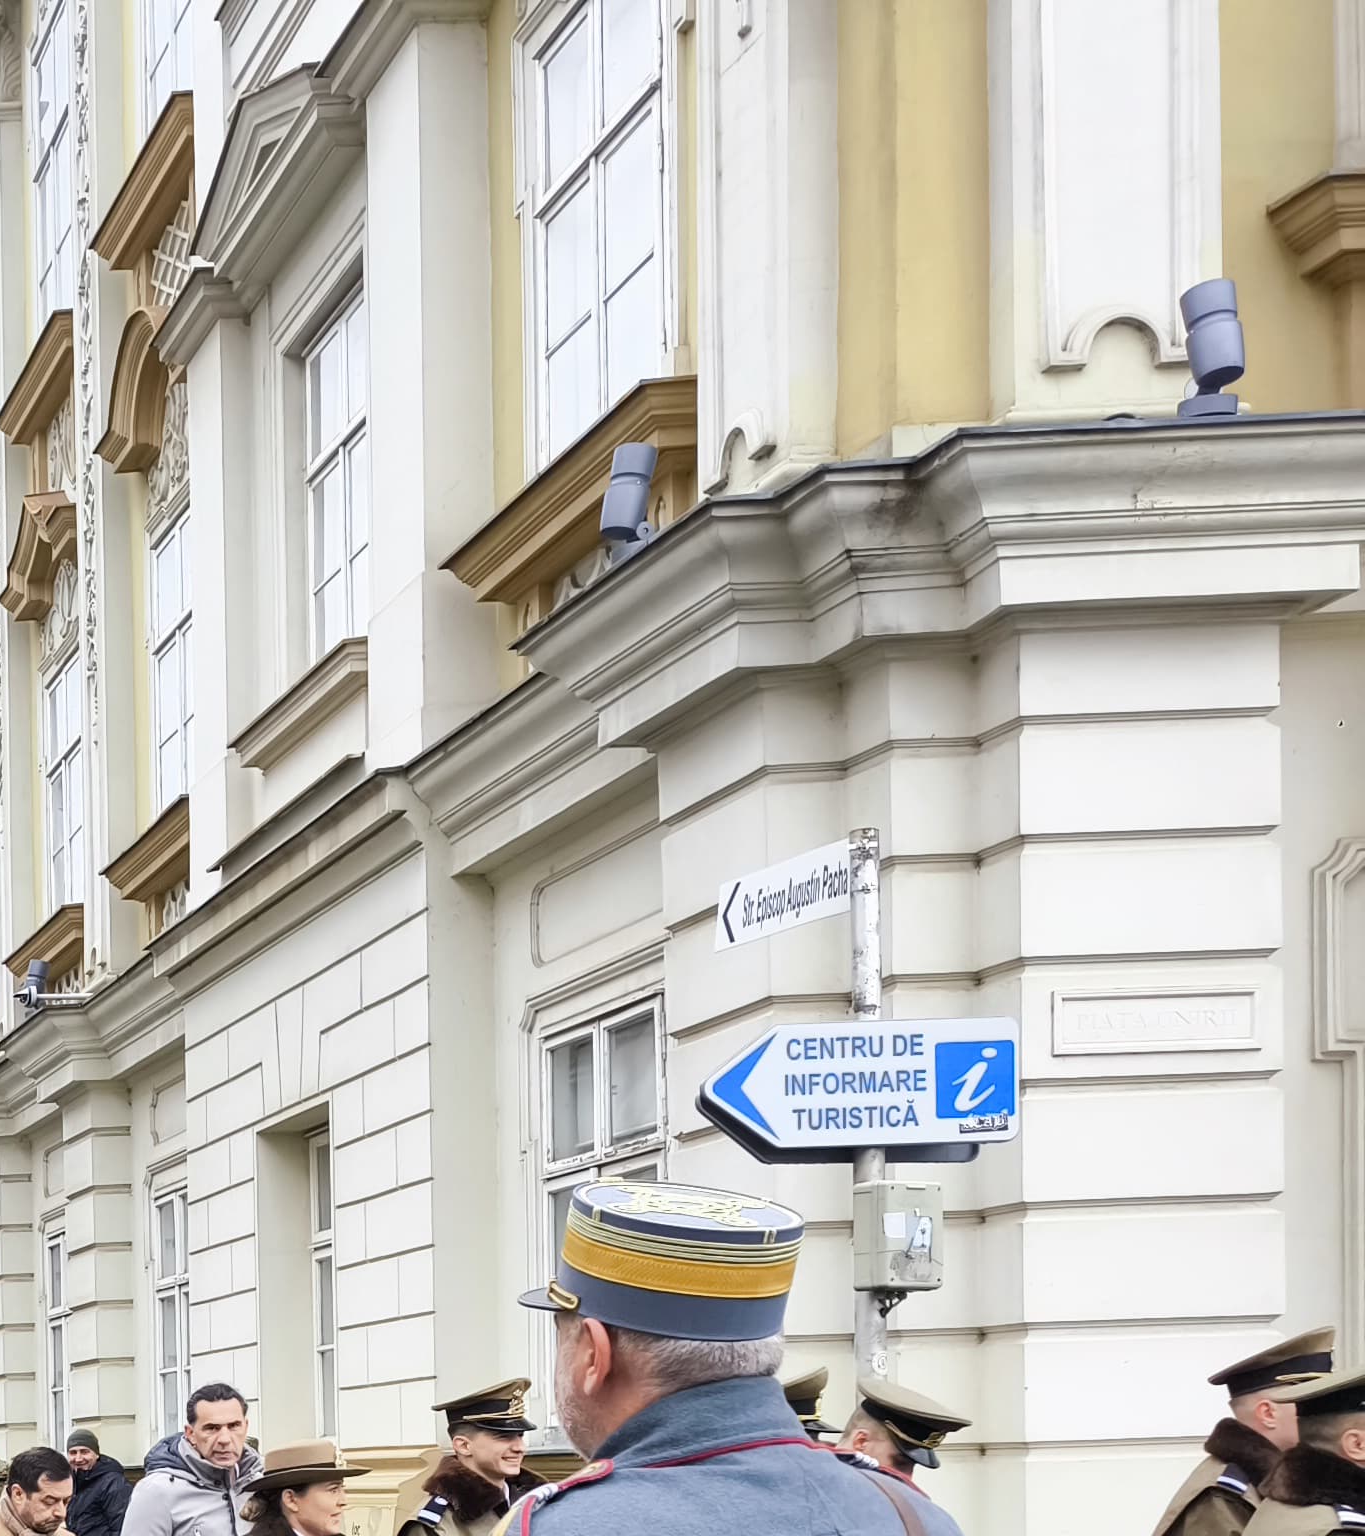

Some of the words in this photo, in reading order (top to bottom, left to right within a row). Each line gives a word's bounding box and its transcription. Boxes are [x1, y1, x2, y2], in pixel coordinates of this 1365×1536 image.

[742, 893, 755, 928] Str.
[756, 886, 786, 930] Episcop
[786, 868, 821, 919] Augustin
[822, 860, 849, 900] Pacha
[785, 1035, 884, 1061] CENTRU
[892, 1033, 925, 1057] DE
[784, 1069, 928, 1097] INFORMARE
[791, 1098, 920, 1131] TURISTICĂ
